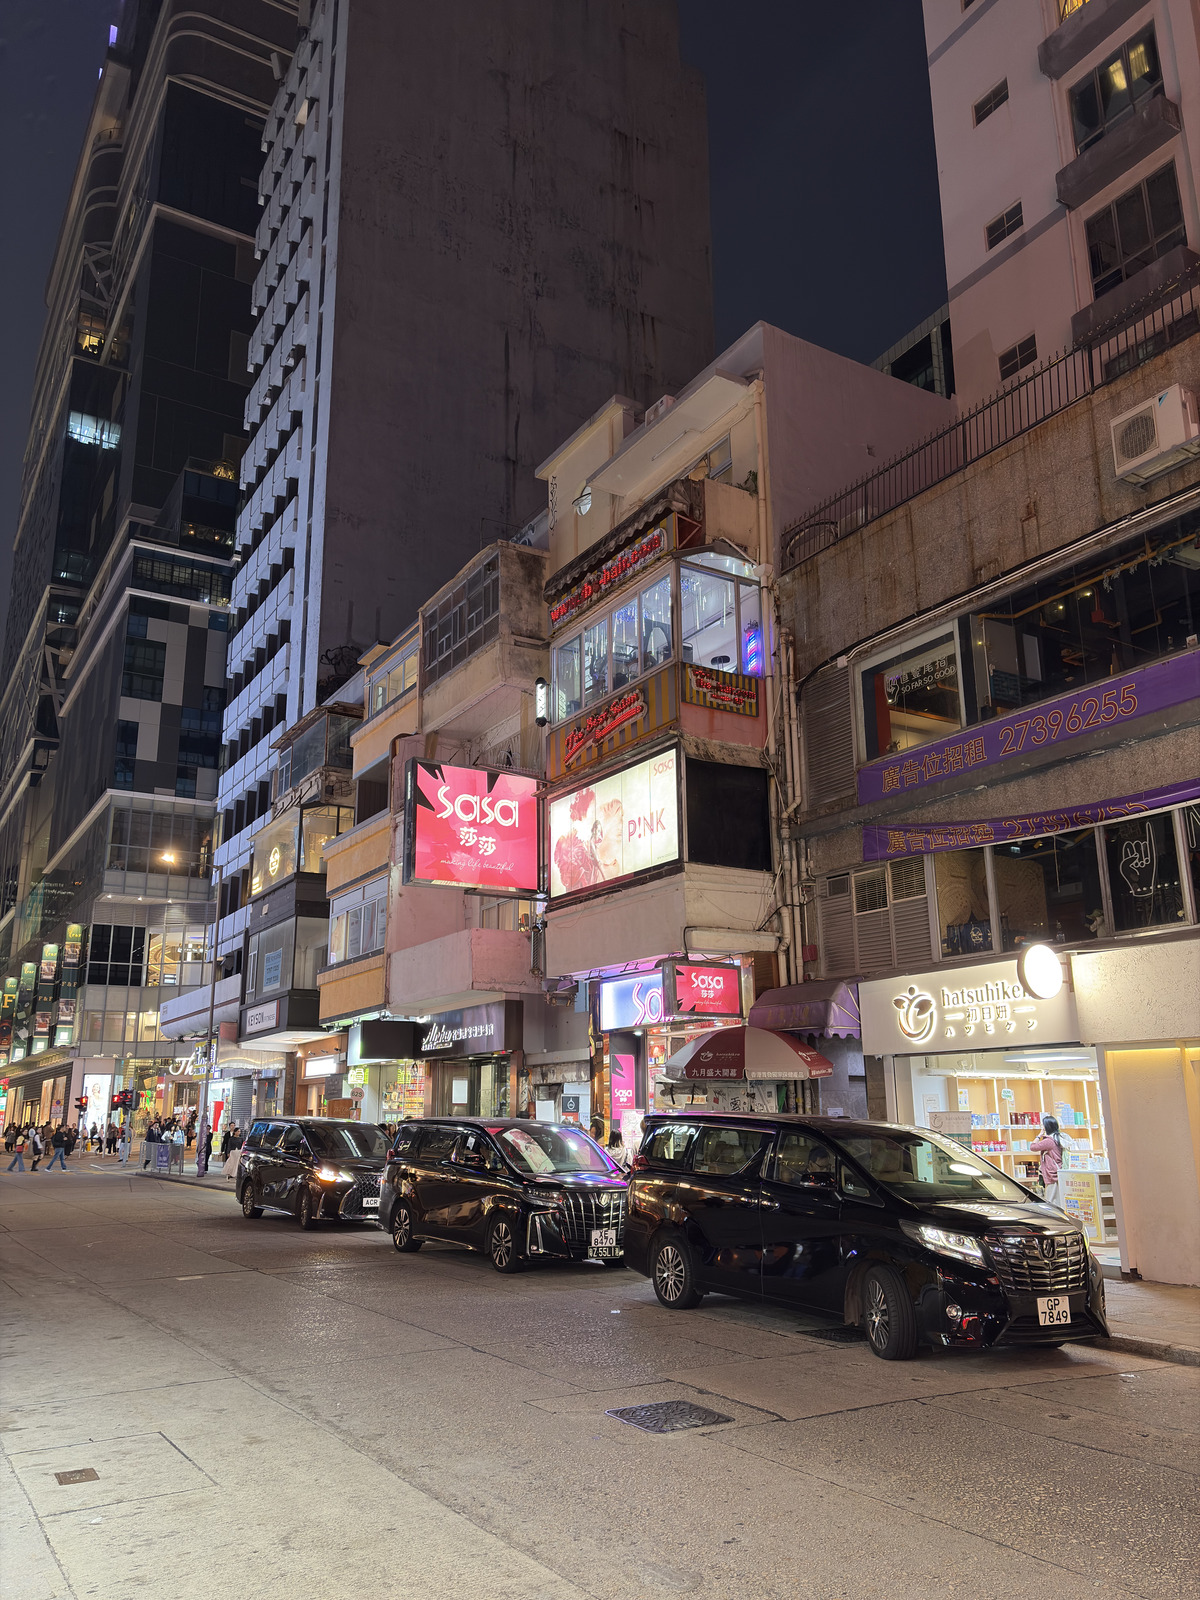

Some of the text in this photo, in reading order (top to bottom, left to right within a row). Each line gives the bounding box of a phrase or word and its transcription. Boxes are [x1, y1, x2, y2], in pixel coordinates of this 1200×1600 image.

[901, 665, 957, 694] SO FAR SO GOOD
[999, 684, 1138, 756] 27396255
[882, 737, 987, 793] 廣告位招租
[628, 808, 666, 842] P!NK
[459, 826, 497, 856] 莎莎
[440, 858, 515, 874] making life beautiful
[966, 1005, 1007, 1022] 初日妍
[691, 1068, 737, 1077] 九月盛大開幕
[593, 1237, 614, 1246] 8470
[599, 1230, 609, 1239] XE
[1046, 1298, 1060, 1311] GP
[1040, 1310, 1068, 1324] 7849
